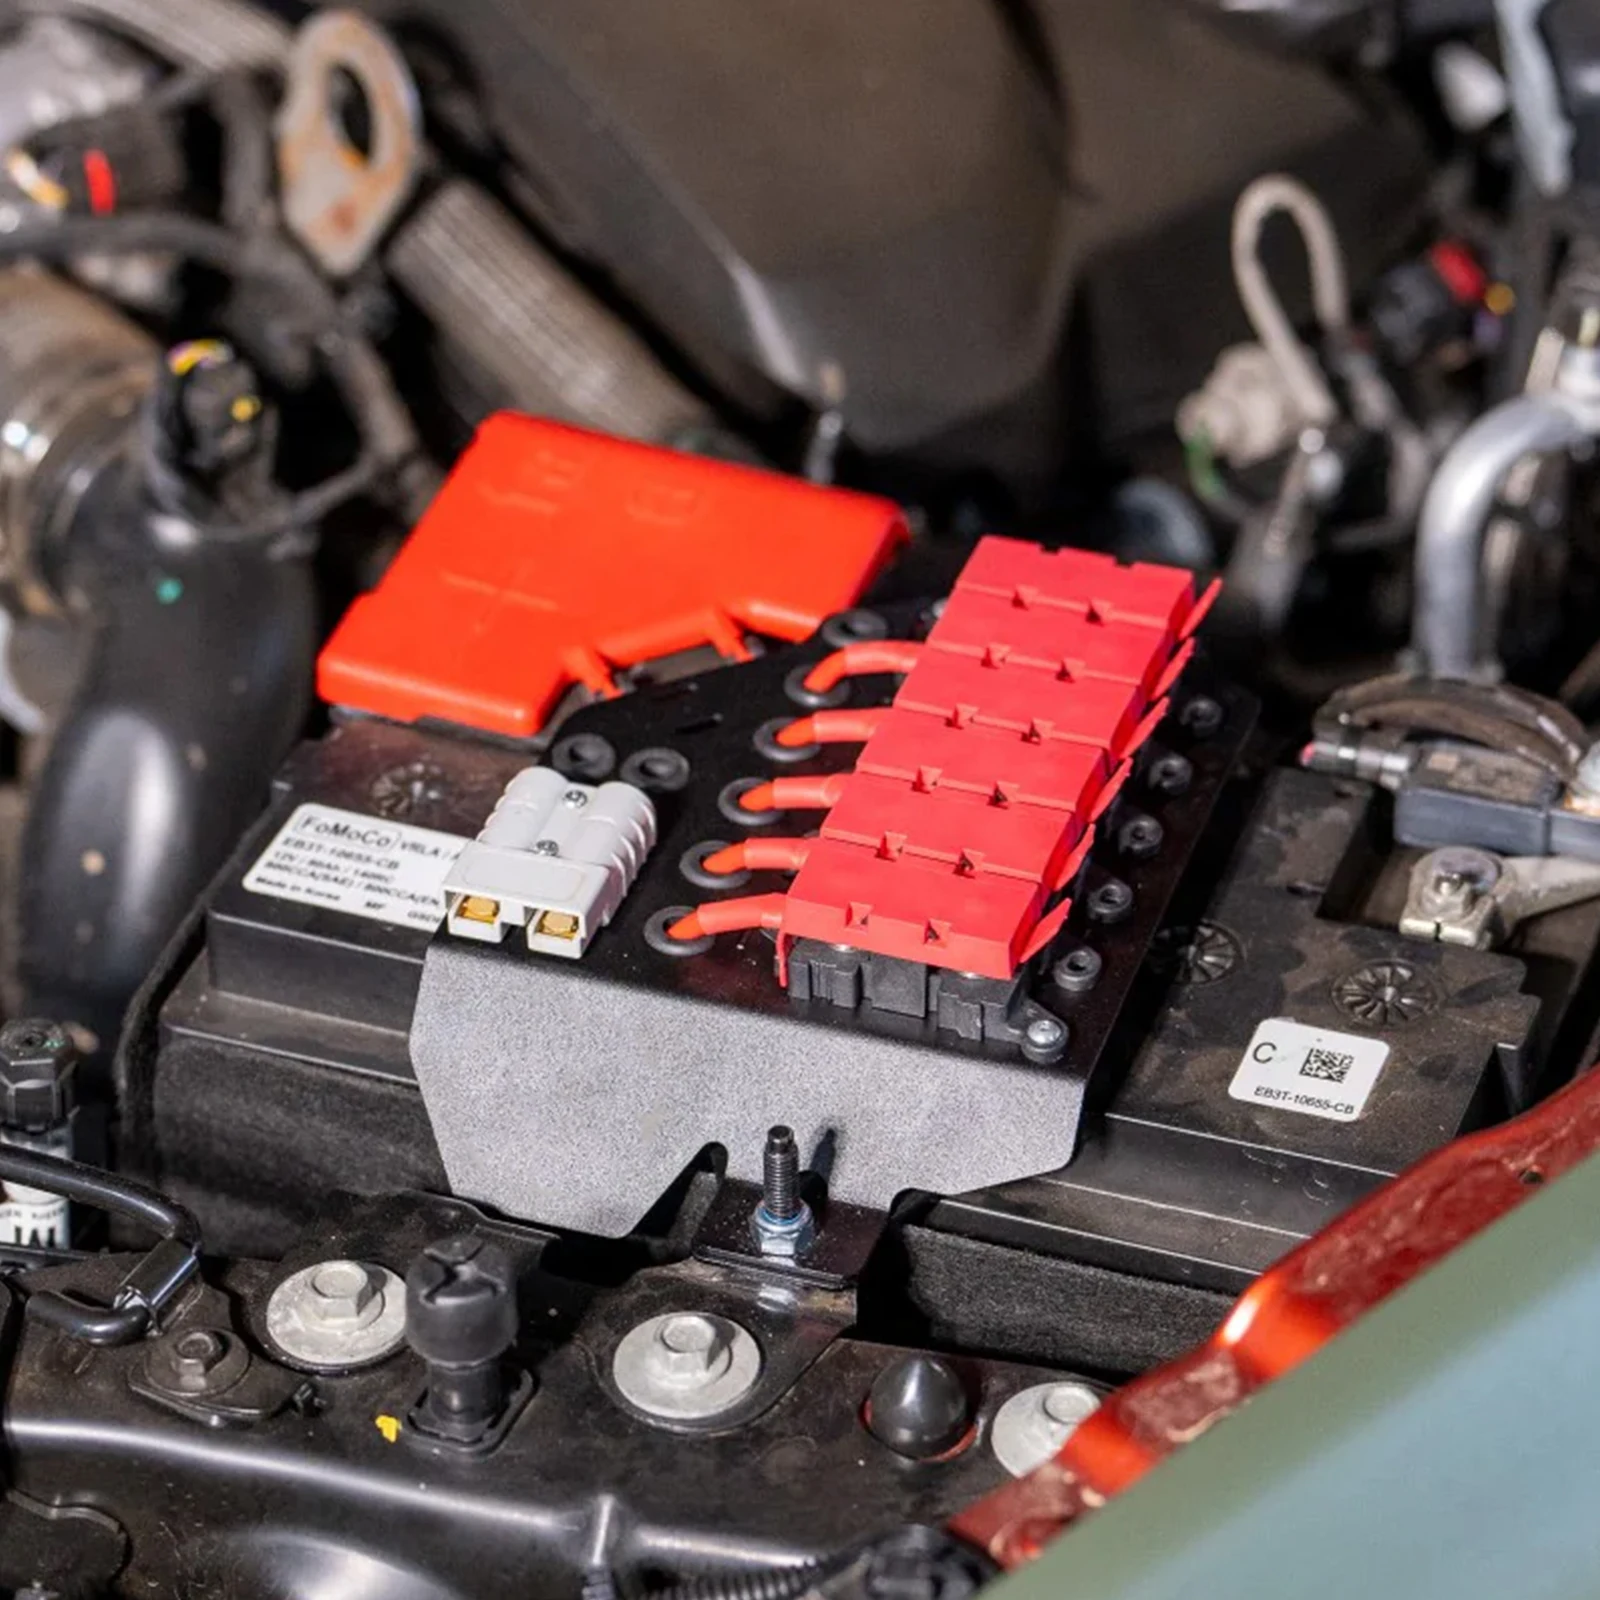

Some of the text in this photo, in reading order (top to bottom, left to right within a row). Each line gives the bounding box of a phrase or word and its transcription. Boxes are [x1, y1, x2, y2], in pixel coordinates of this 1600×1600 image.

[301, 815, 390, 847] FoMoCo
[1252, 1041, 1278, 1065] C
[1253, 1085, 1355, 1115] EB3T-10655-CB
